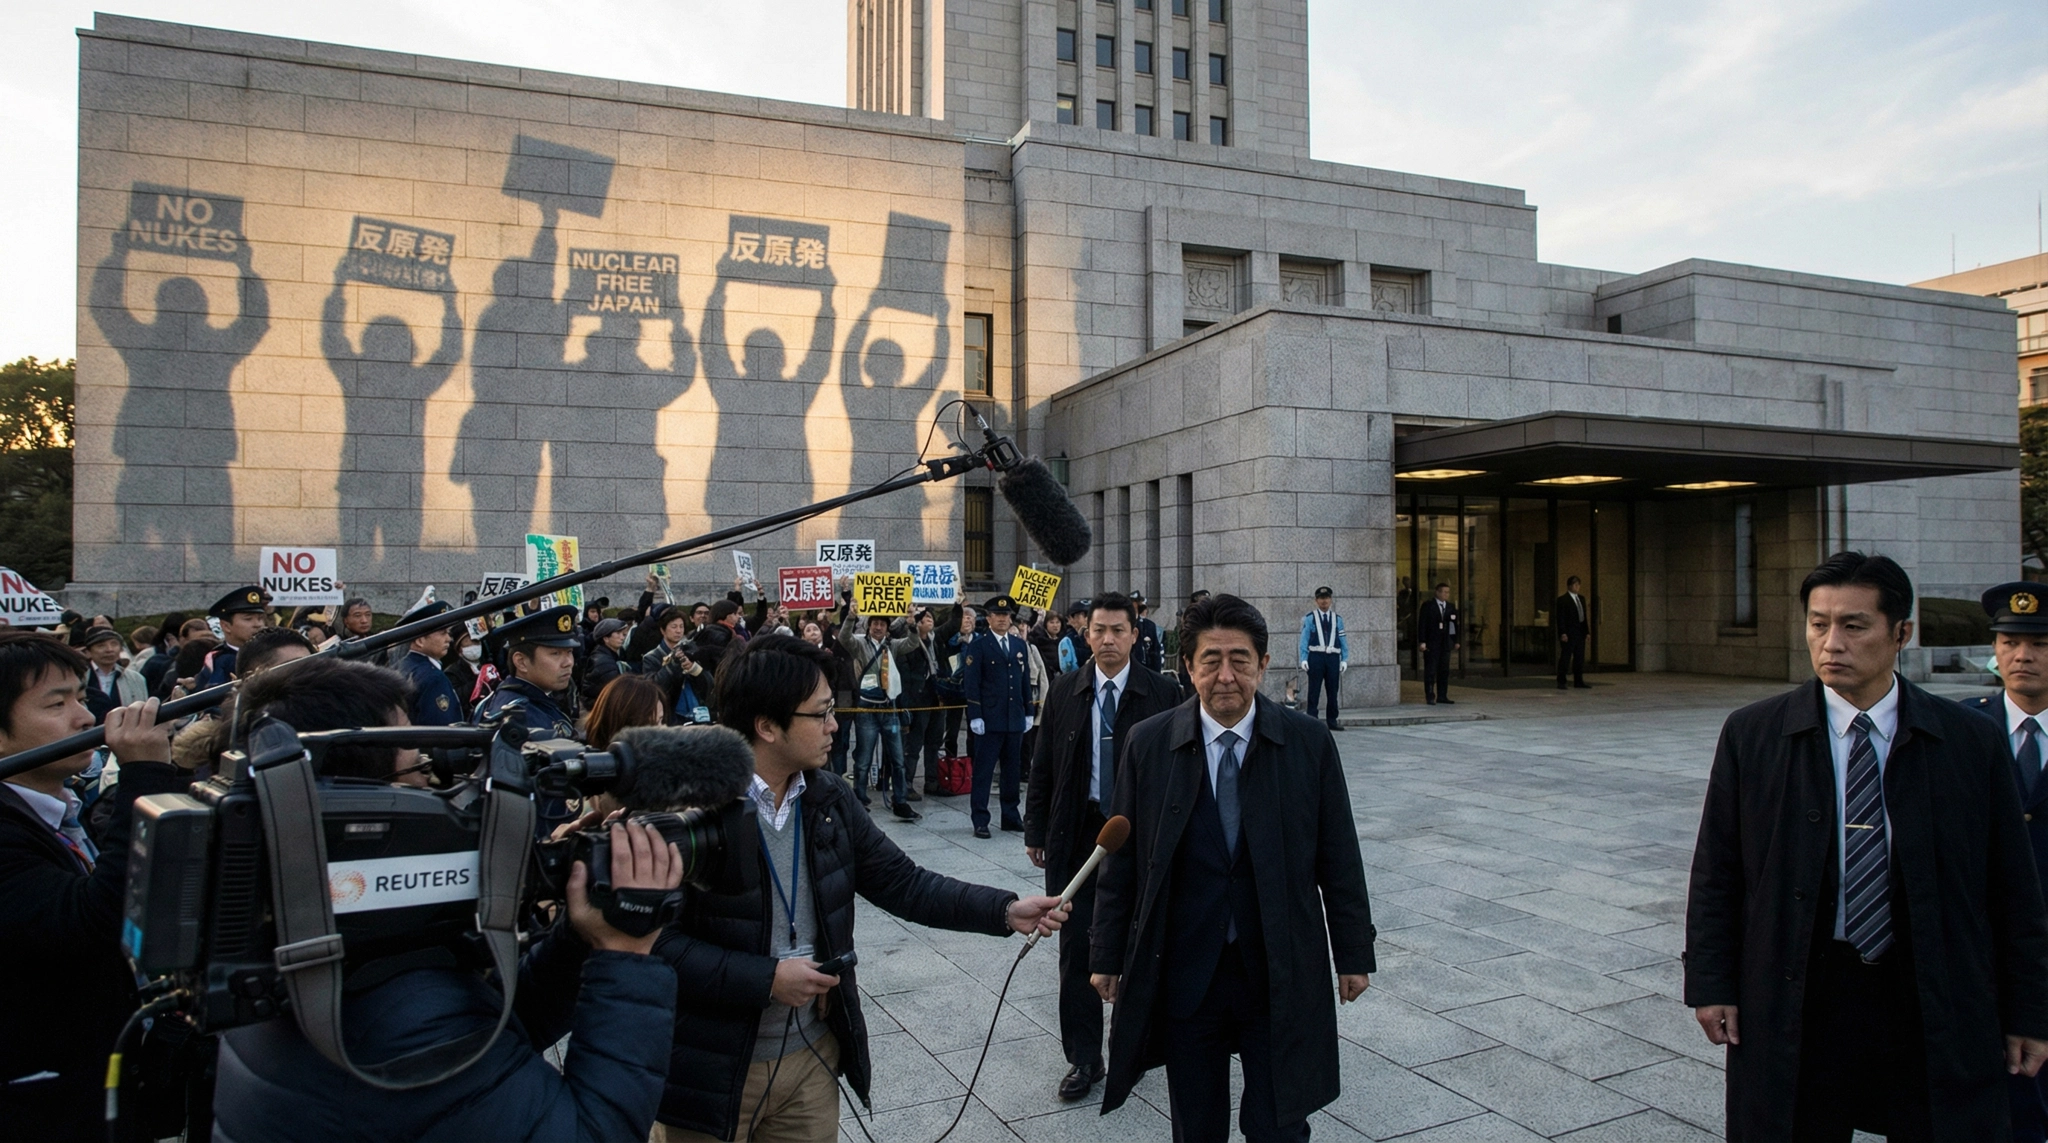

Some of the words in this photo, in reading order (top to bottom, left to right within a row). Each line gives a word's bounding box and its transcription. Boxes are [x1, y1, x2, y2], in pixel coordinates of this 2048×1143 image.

[157, 194, 213, 225] NO
[129, 219, 238, 253] NUKES
[353, 223, 450, 265] 反原発
[730, 231, 826, 269] 反原発
[572, 251, 676, 275] NUCLEAR
[596, 273, 653, 294] FREE
[587, 294, 660, 314] JAPAN
[272, 552, 316, 574] NO
[819, 544, 872, 562] 反原発
[263, 577, 333, 592] NUKES
[482, 577, 530, 597] 反原
[856, 575, 911, 587] NUCLEAR
[1018, 569, 1058, 587] NUCLEAR
[782, 576, 832, 602] 反原発
[863, 586, 905, 601] FREE
[1020, 580, 1050, 598] FREE
[860, 601, 906, 614] JAPAN
[1014, 592, 1048, 608] JAPAN
[375, 868, 470, 892] REUTERS
